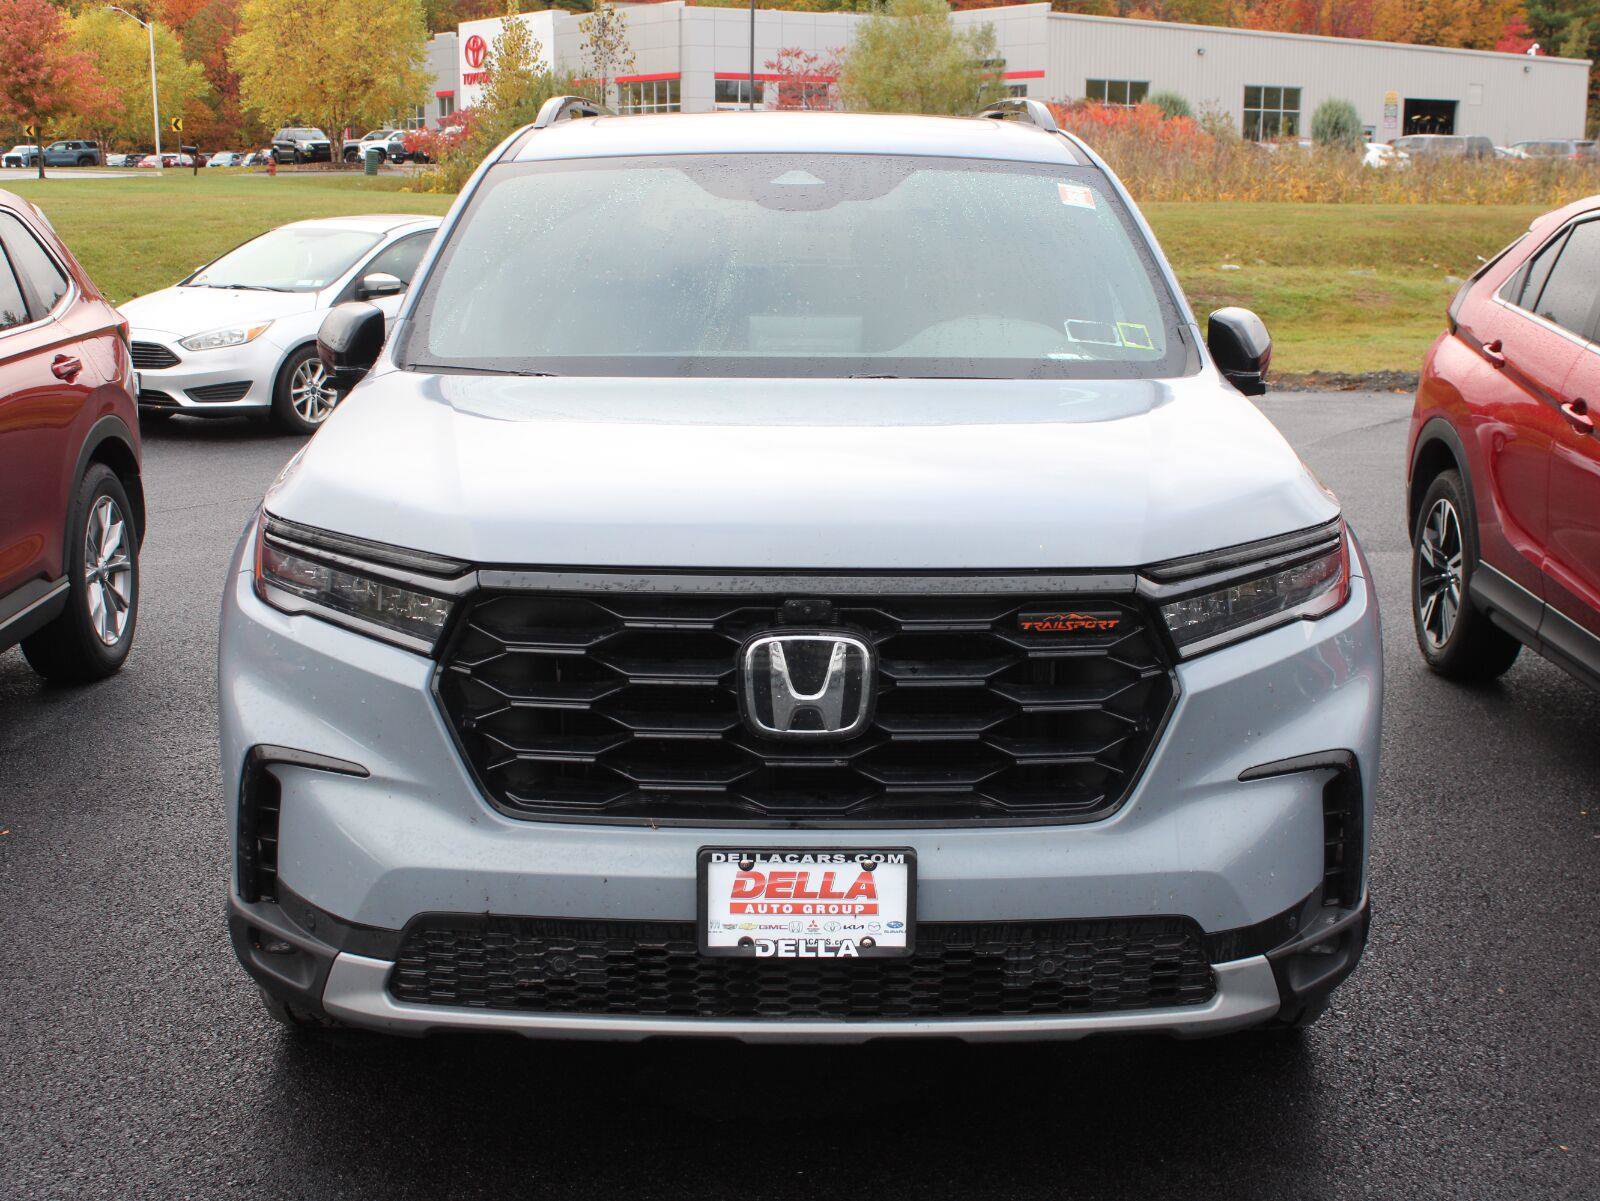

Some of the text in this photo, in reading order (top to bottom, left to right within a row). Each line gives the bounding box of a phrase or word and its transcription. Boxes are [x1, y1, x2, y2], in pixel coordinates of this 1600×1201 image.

[1021, 620, 1119, 632] TRAILSPORT
[711, 853, 904, 864] DELLACARS.COM
[730, 871, 878, 900] DELLA
[744, 903, 865, 914] AUTO GROUP
[755, 939, 859, 958] DELLA
